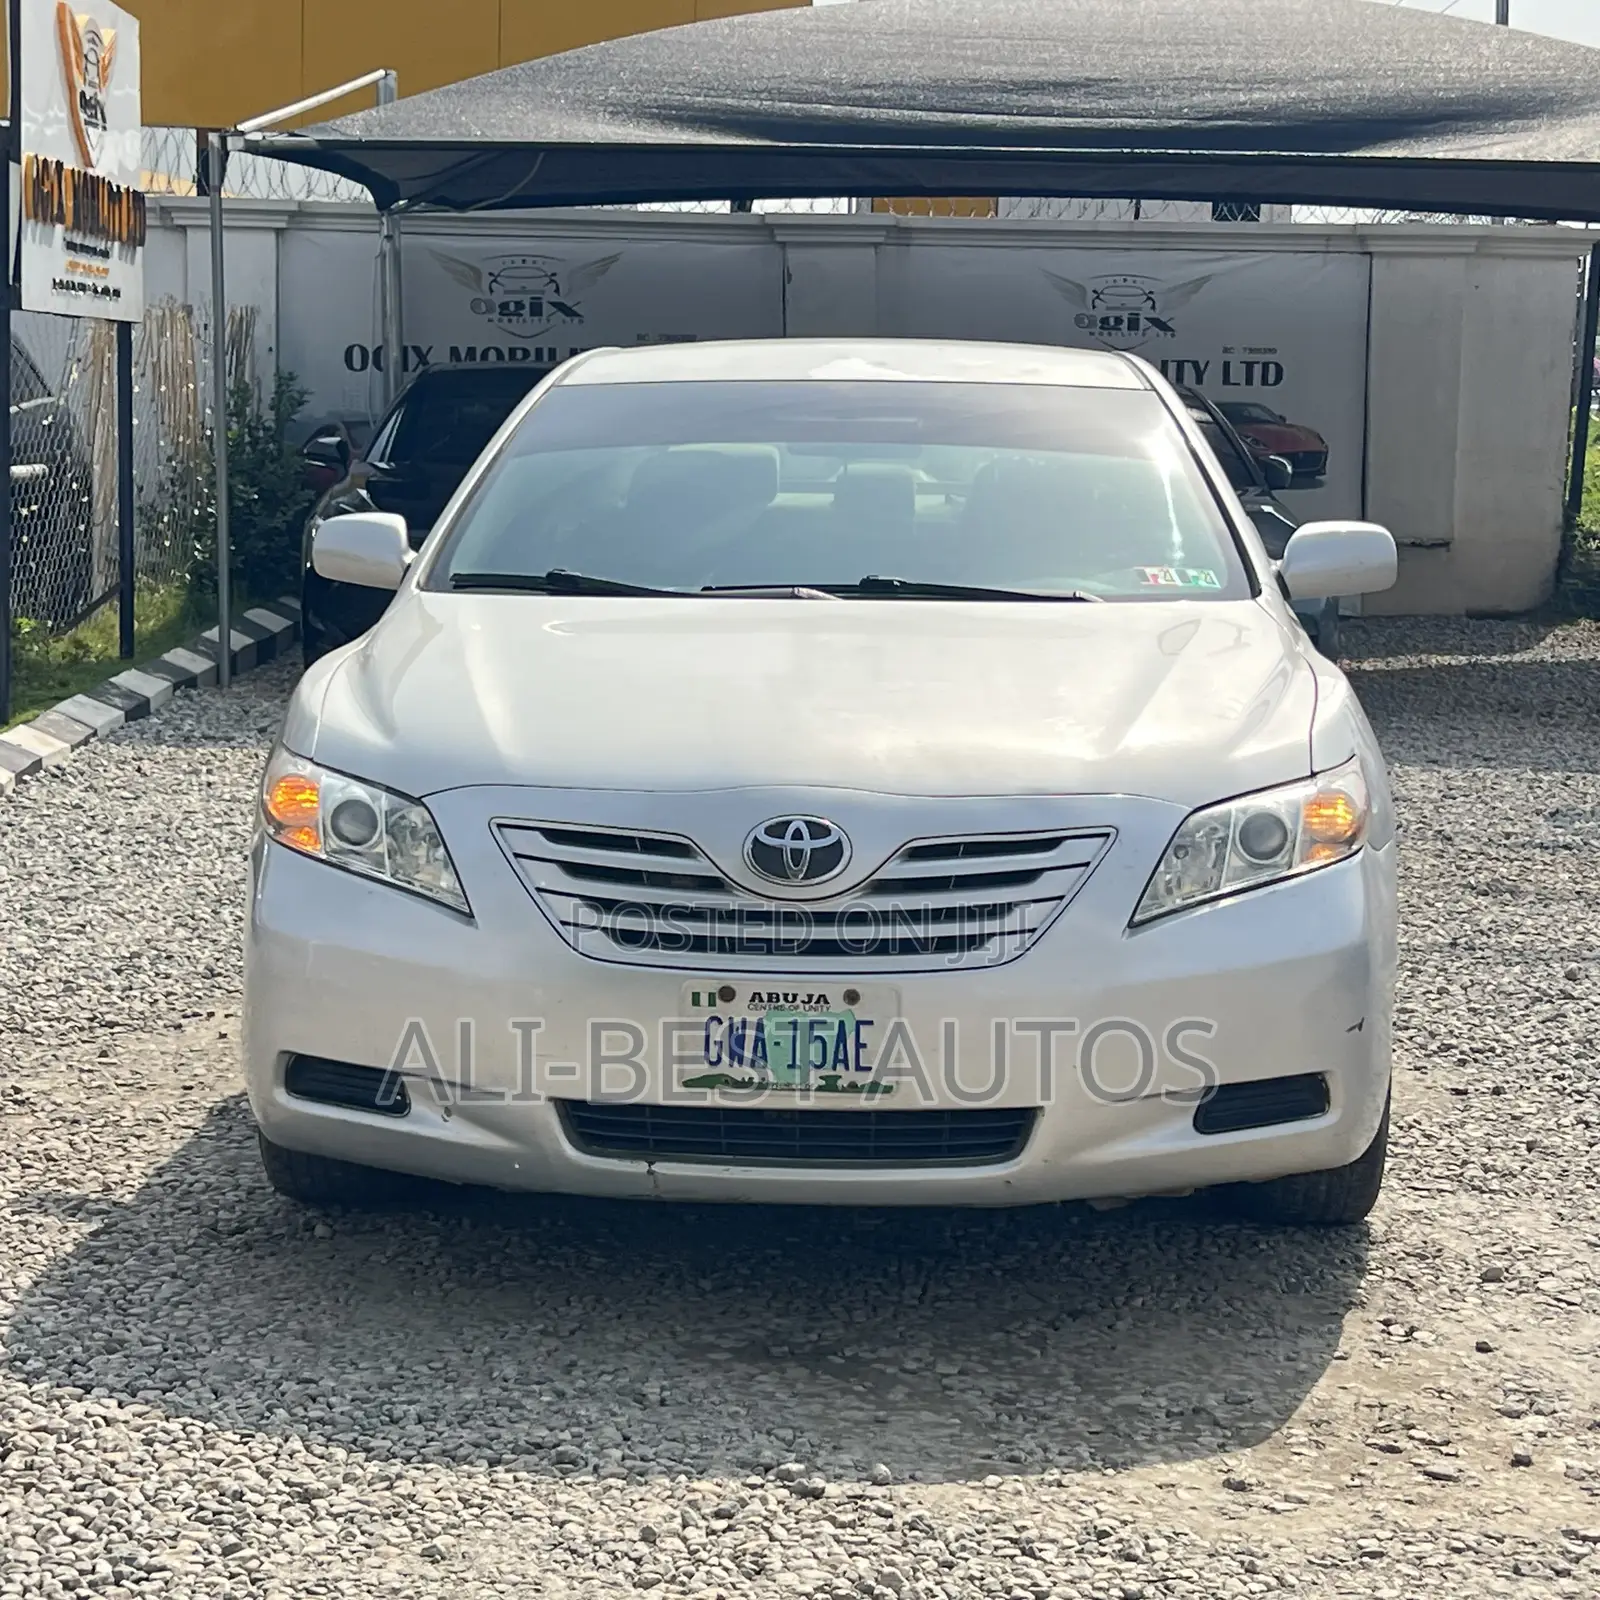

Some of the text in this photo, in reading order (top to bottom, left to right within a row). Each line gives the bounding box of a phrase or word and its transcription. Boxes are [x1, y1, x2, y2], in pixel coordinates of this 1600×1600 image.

[1160, 359, 1284, 387] ITY LTD
[748, 991, 831, 1005] ABUJA
[747, 1002, 832, 1013] CENTRE OF UNITY
